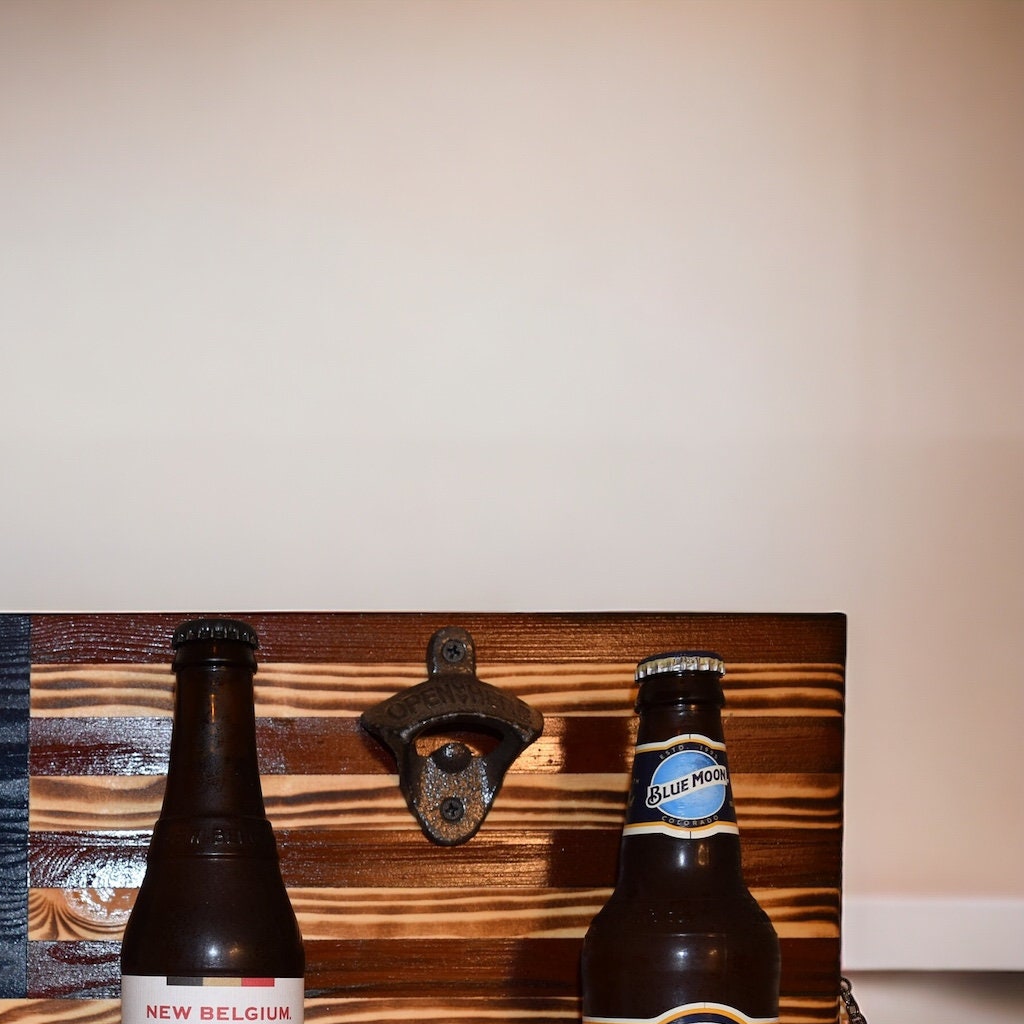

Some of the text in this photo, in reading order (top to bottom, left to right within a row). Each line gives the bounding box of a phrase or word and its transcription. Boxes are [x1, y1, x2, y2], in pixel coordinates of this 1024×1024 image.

[647, 769, 726, 806] BLUE MOON
[661, 815, 719, 826] COLORADO
[146, 1005, 192, 1020] NEW
